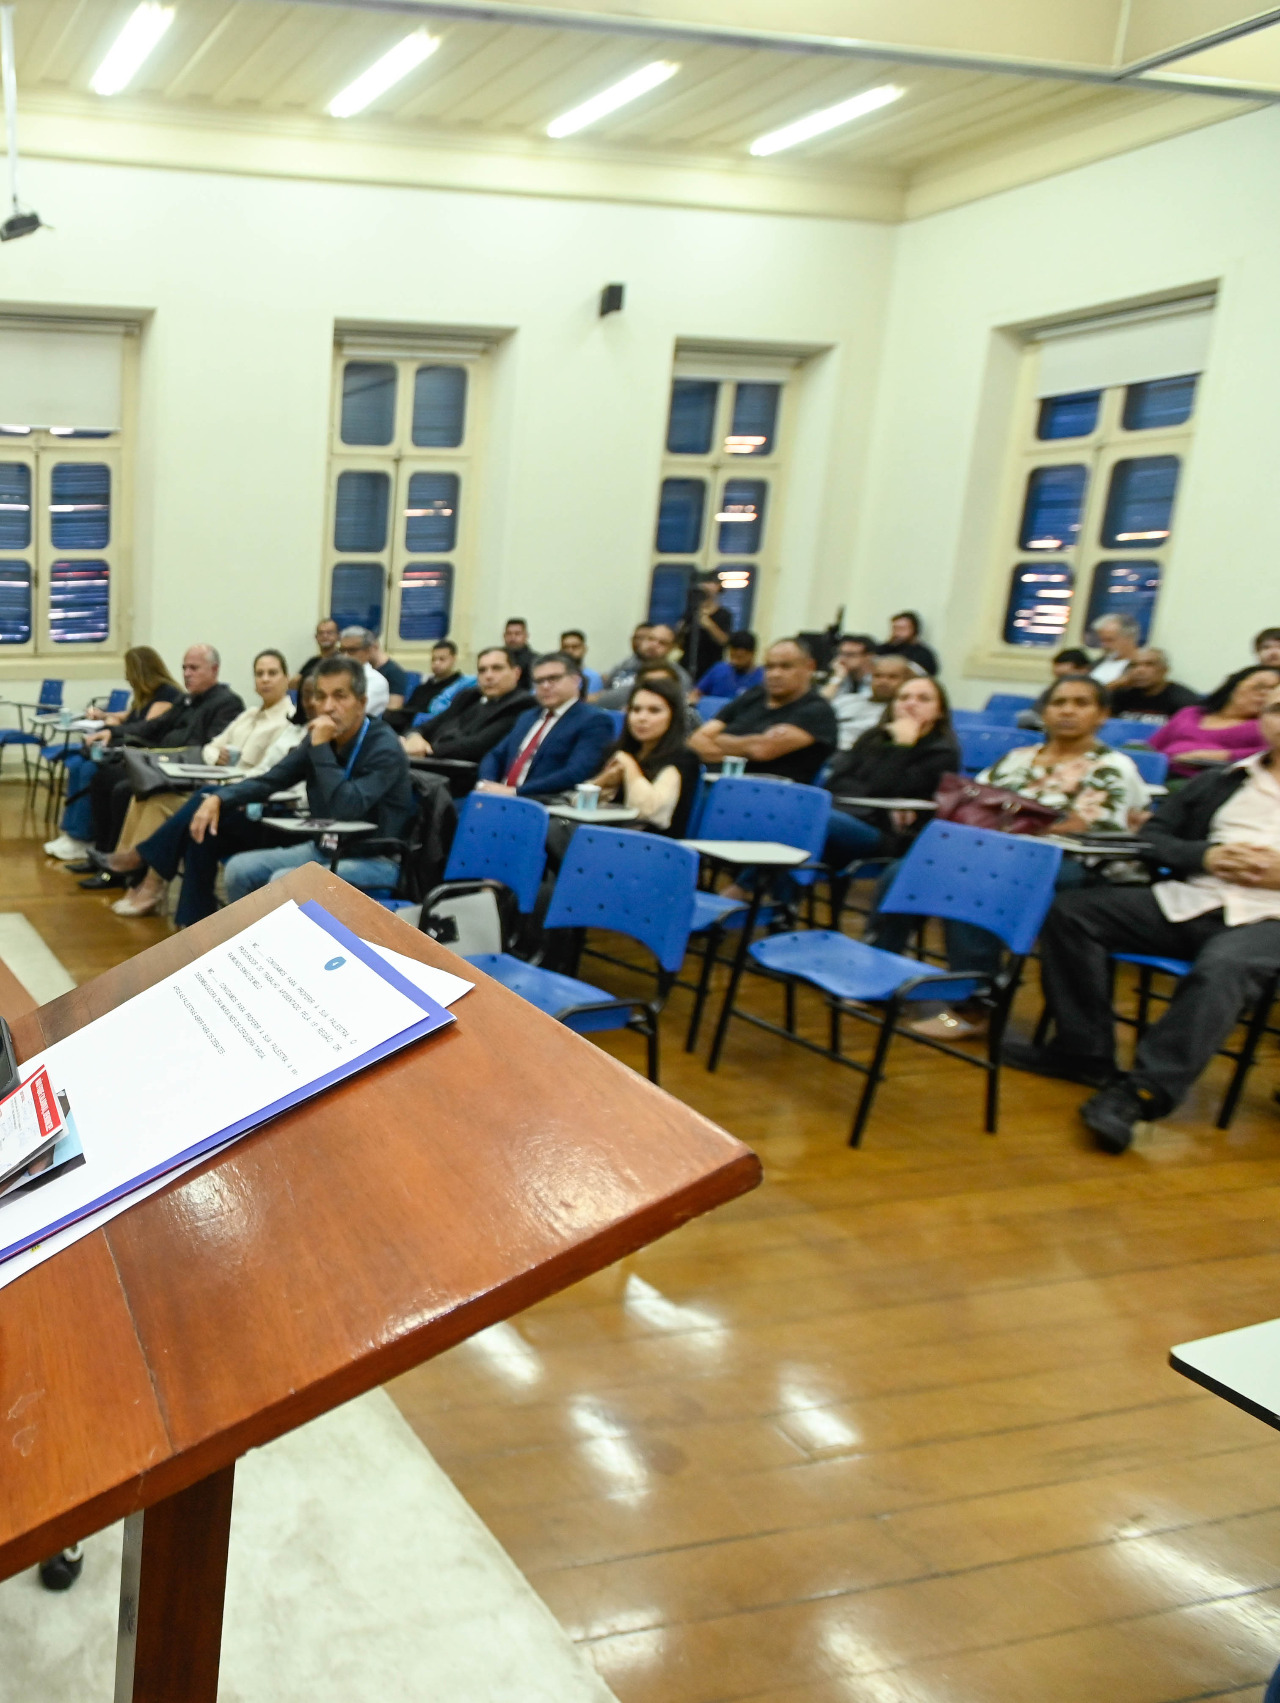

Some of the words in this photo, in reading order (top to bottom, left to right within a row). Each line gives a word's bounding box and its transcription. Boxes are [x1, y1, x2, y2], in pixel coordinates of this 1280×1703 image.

[219, 1003, 231, 1015] MARIA
[261, 971, 280, 989] TRABALHO
[299, 1010, 312, 1021] PELA
[285, 976, 298, 987] PARA
[295, 986, 315, 1004] PROFERIR
[318, 1008, 330, 1018] SUA
[235, 1001, 246, 1012] PARA
[243, 1011, 262, 1031] PROFERIR
[262, 1033, 272, 1043] SUA
